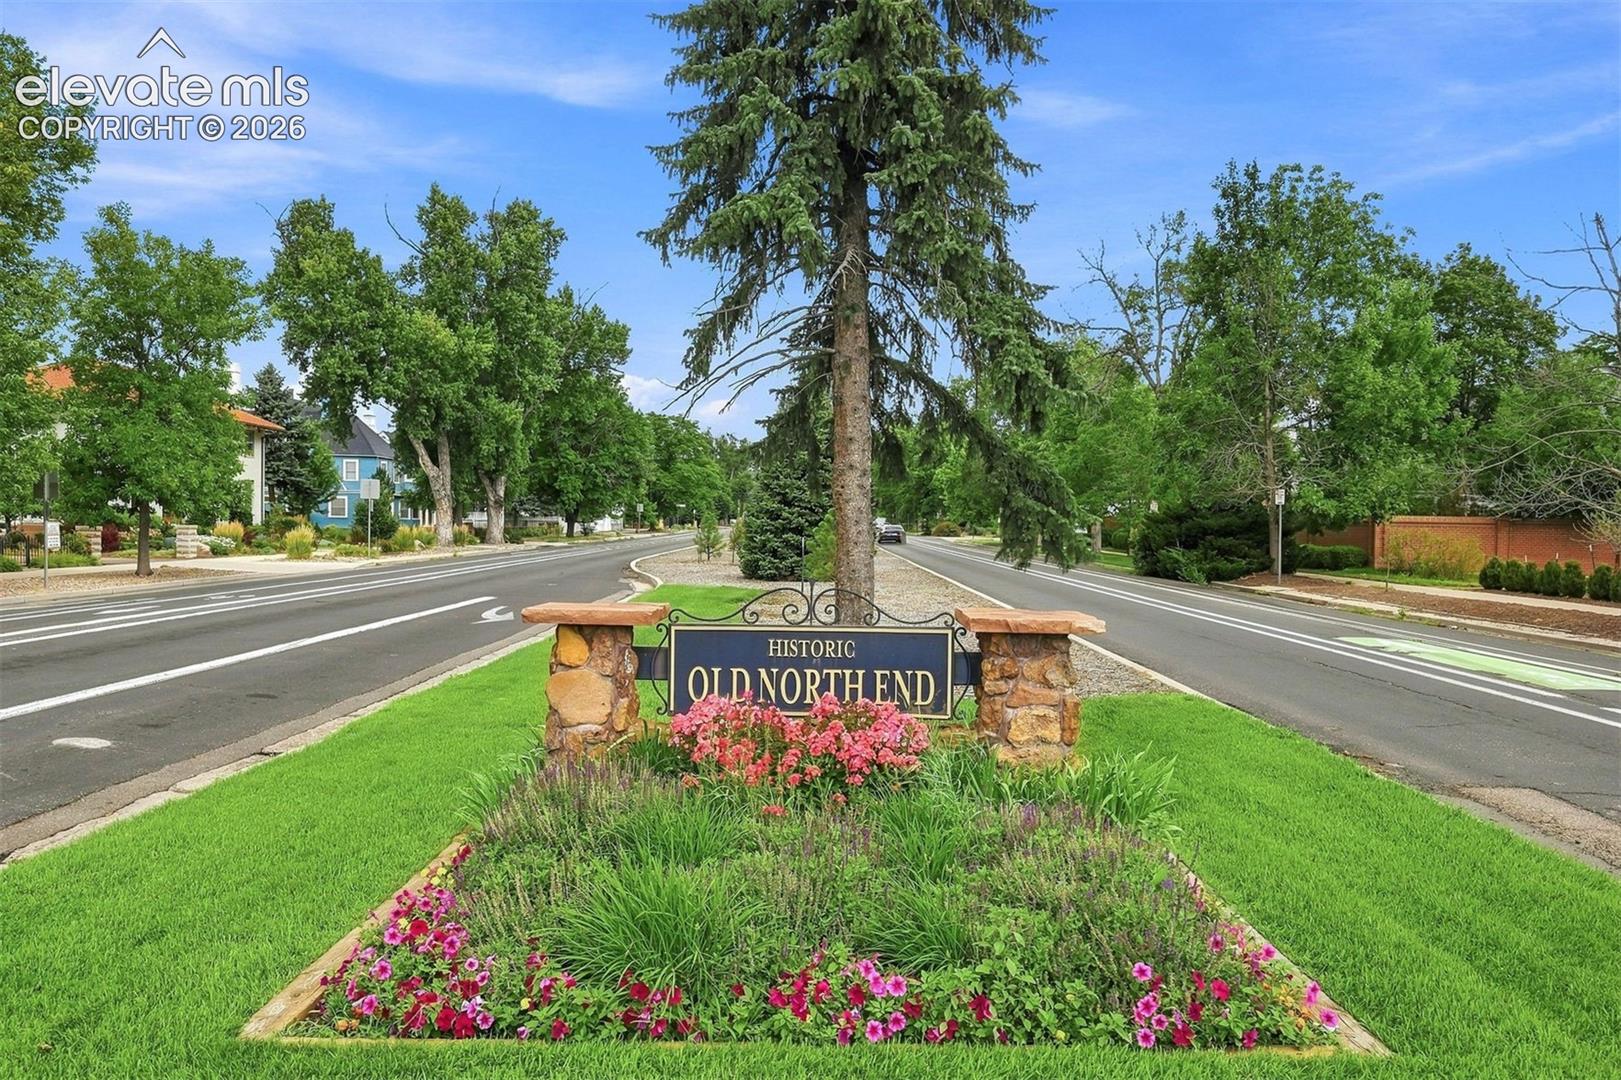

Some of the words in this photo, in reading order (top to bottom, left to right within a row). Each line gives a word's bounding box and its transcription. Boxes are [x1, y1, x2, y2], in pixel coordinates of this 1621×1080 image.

[768, 639, 856, 659] HISTORIC
[687, 665, 751, 704] OLD
[757, 667, 867, 705] NORTH
[874, 669, 936, 706] END
